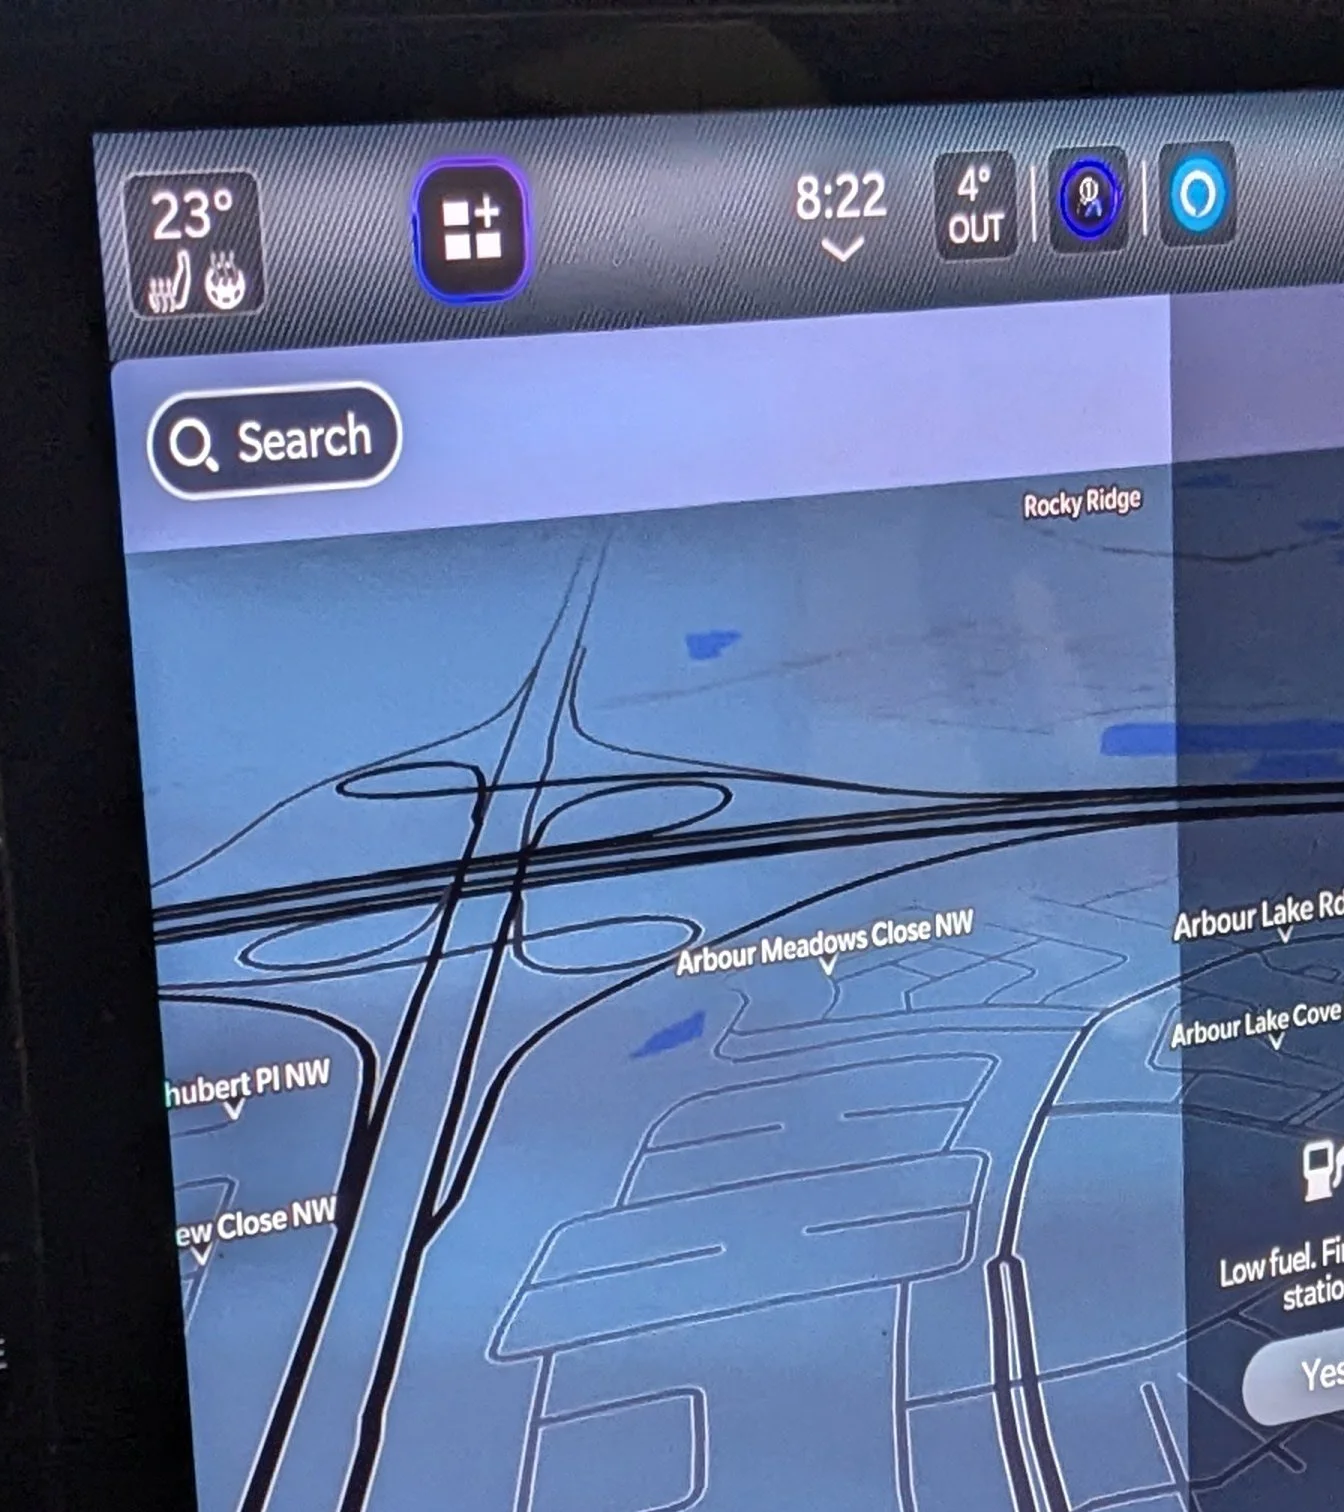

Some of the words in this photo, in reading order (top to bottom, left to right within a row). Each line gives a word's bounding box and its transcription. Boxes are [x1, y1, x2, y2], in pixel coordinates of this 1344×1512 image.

[796, 172, 887, 221] 8:22
[949, 213, 1004, 246] OUT
[237, 412, 372, 463] Search
[1023, 492, 1082, 519] Rocky
[1086, 486, 1142, 516] Ridge
[1174, 909, 1257, 940] Arbour
[1260, 897, 1315, 927] Lake
[676, 943, 757, 976] Arbour
[759, 930, 868, 963] Meadows
[871, 917, 930, 948] Close
[935, 909, 974, 937] NW
[1171, 1020, 1239, 1048] Arbour
[1245, 1010, 1289, 1035] Lake
[1291, 1000, 1341, 1027] Cove
[255, 1066, 279, 1093] Pl
[285, 1058, 330, 1088] NW
[217, 1207, 288, 1239] Close
[292, 1196, 336, 1227] NW
[1220, 1258, 1266, 1288] Low
[1269, 1244, 1317, 1280] fuel.
